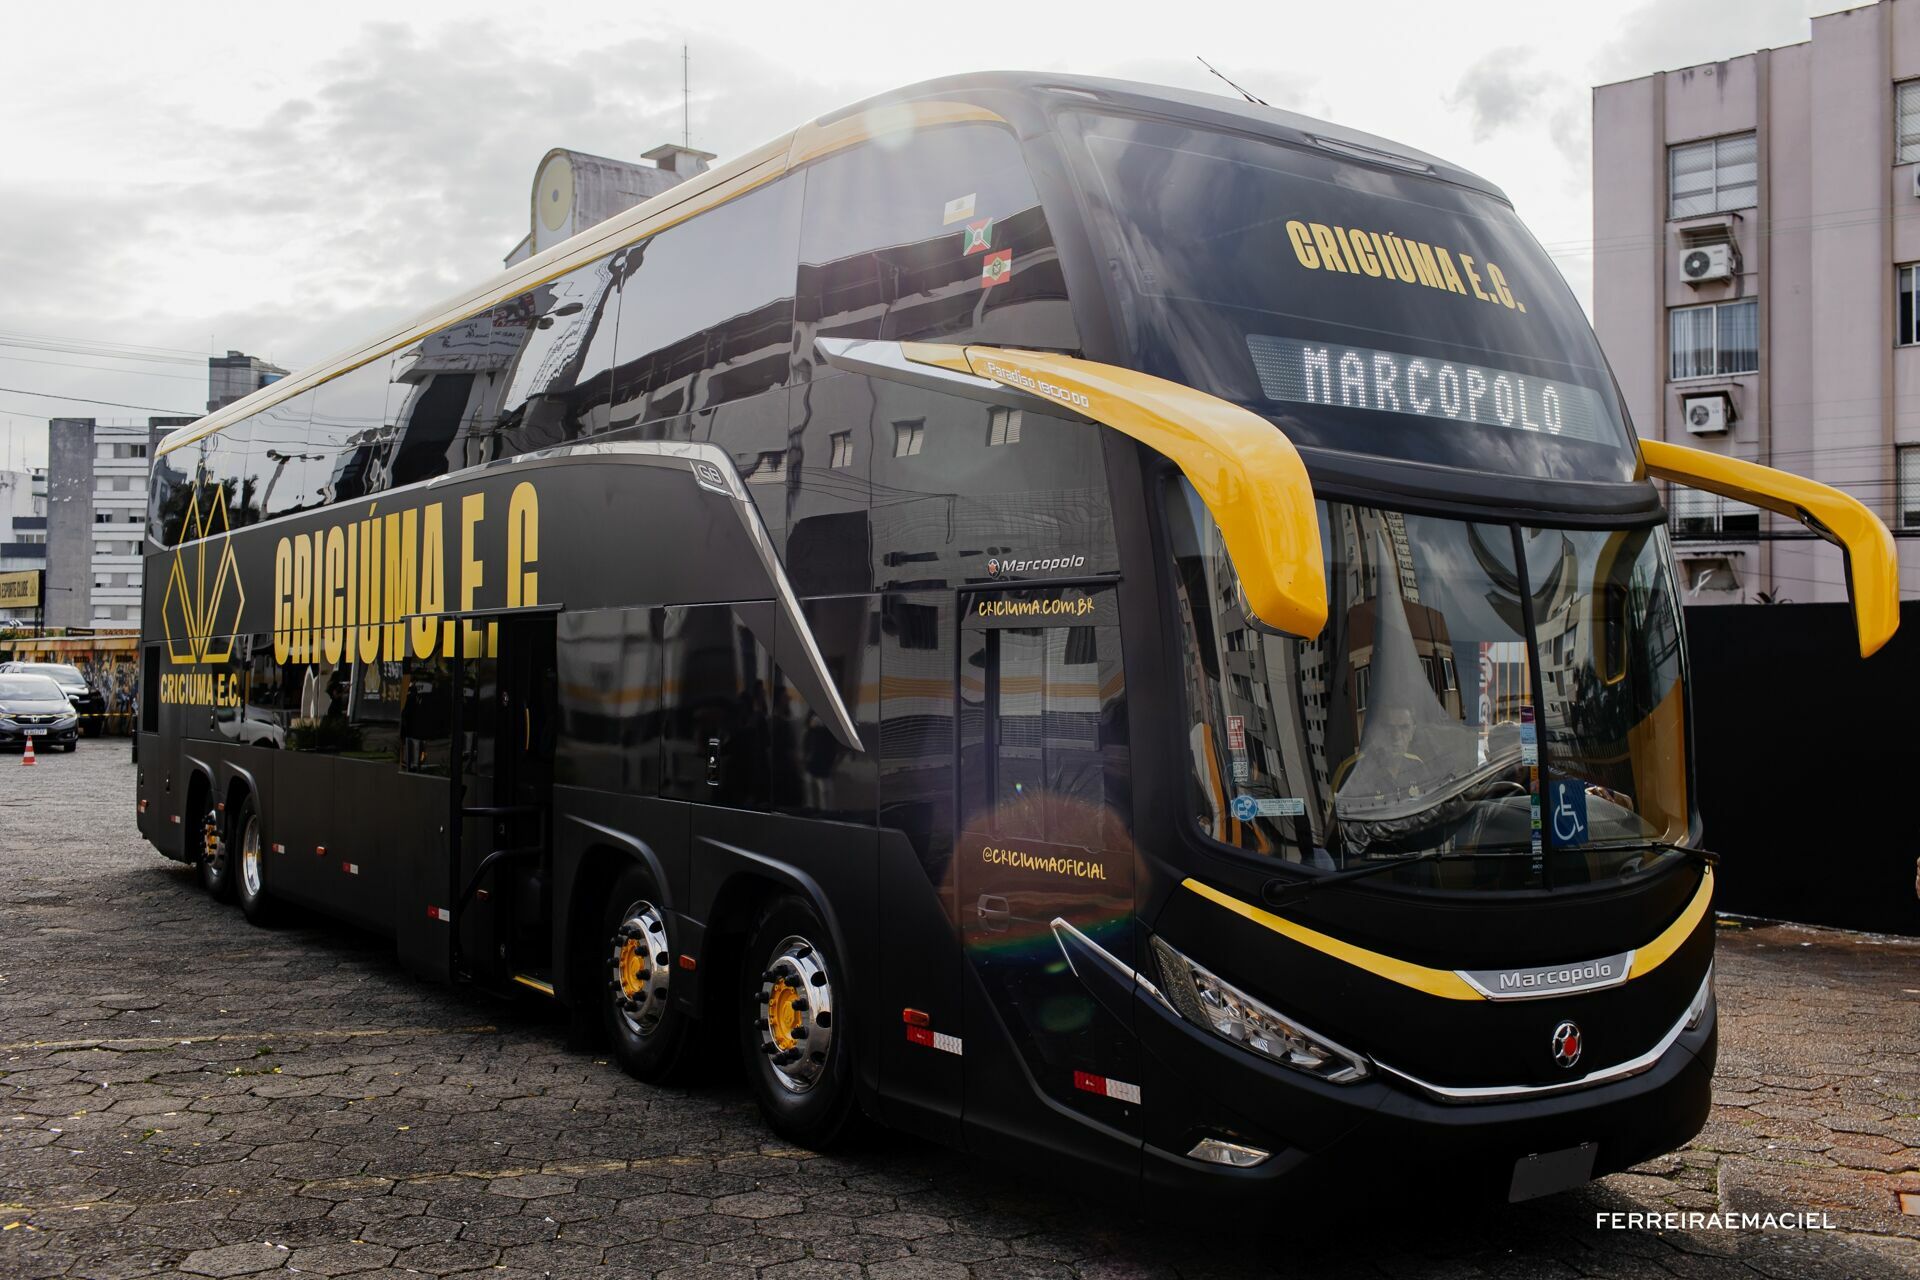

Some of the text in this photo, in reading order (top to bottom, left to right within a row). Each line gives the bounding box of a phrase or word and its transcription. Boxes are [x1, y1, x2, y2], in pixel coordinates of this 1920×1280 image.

[1286, 220, 1527, 313] CRICIÚMA E.C.
[987, 362, 1036, 389] Paradiso
[1303, 347, 1562, 435] MARCOPOLO
[274, 502, 446, 665] CRICIÚMA
[1001, 554, 1085, 572] Marcopolo
[160, 665, 241, 707] CRICIÚMA E.C.
[1500, 962, 1612, 989] Marcopolo
